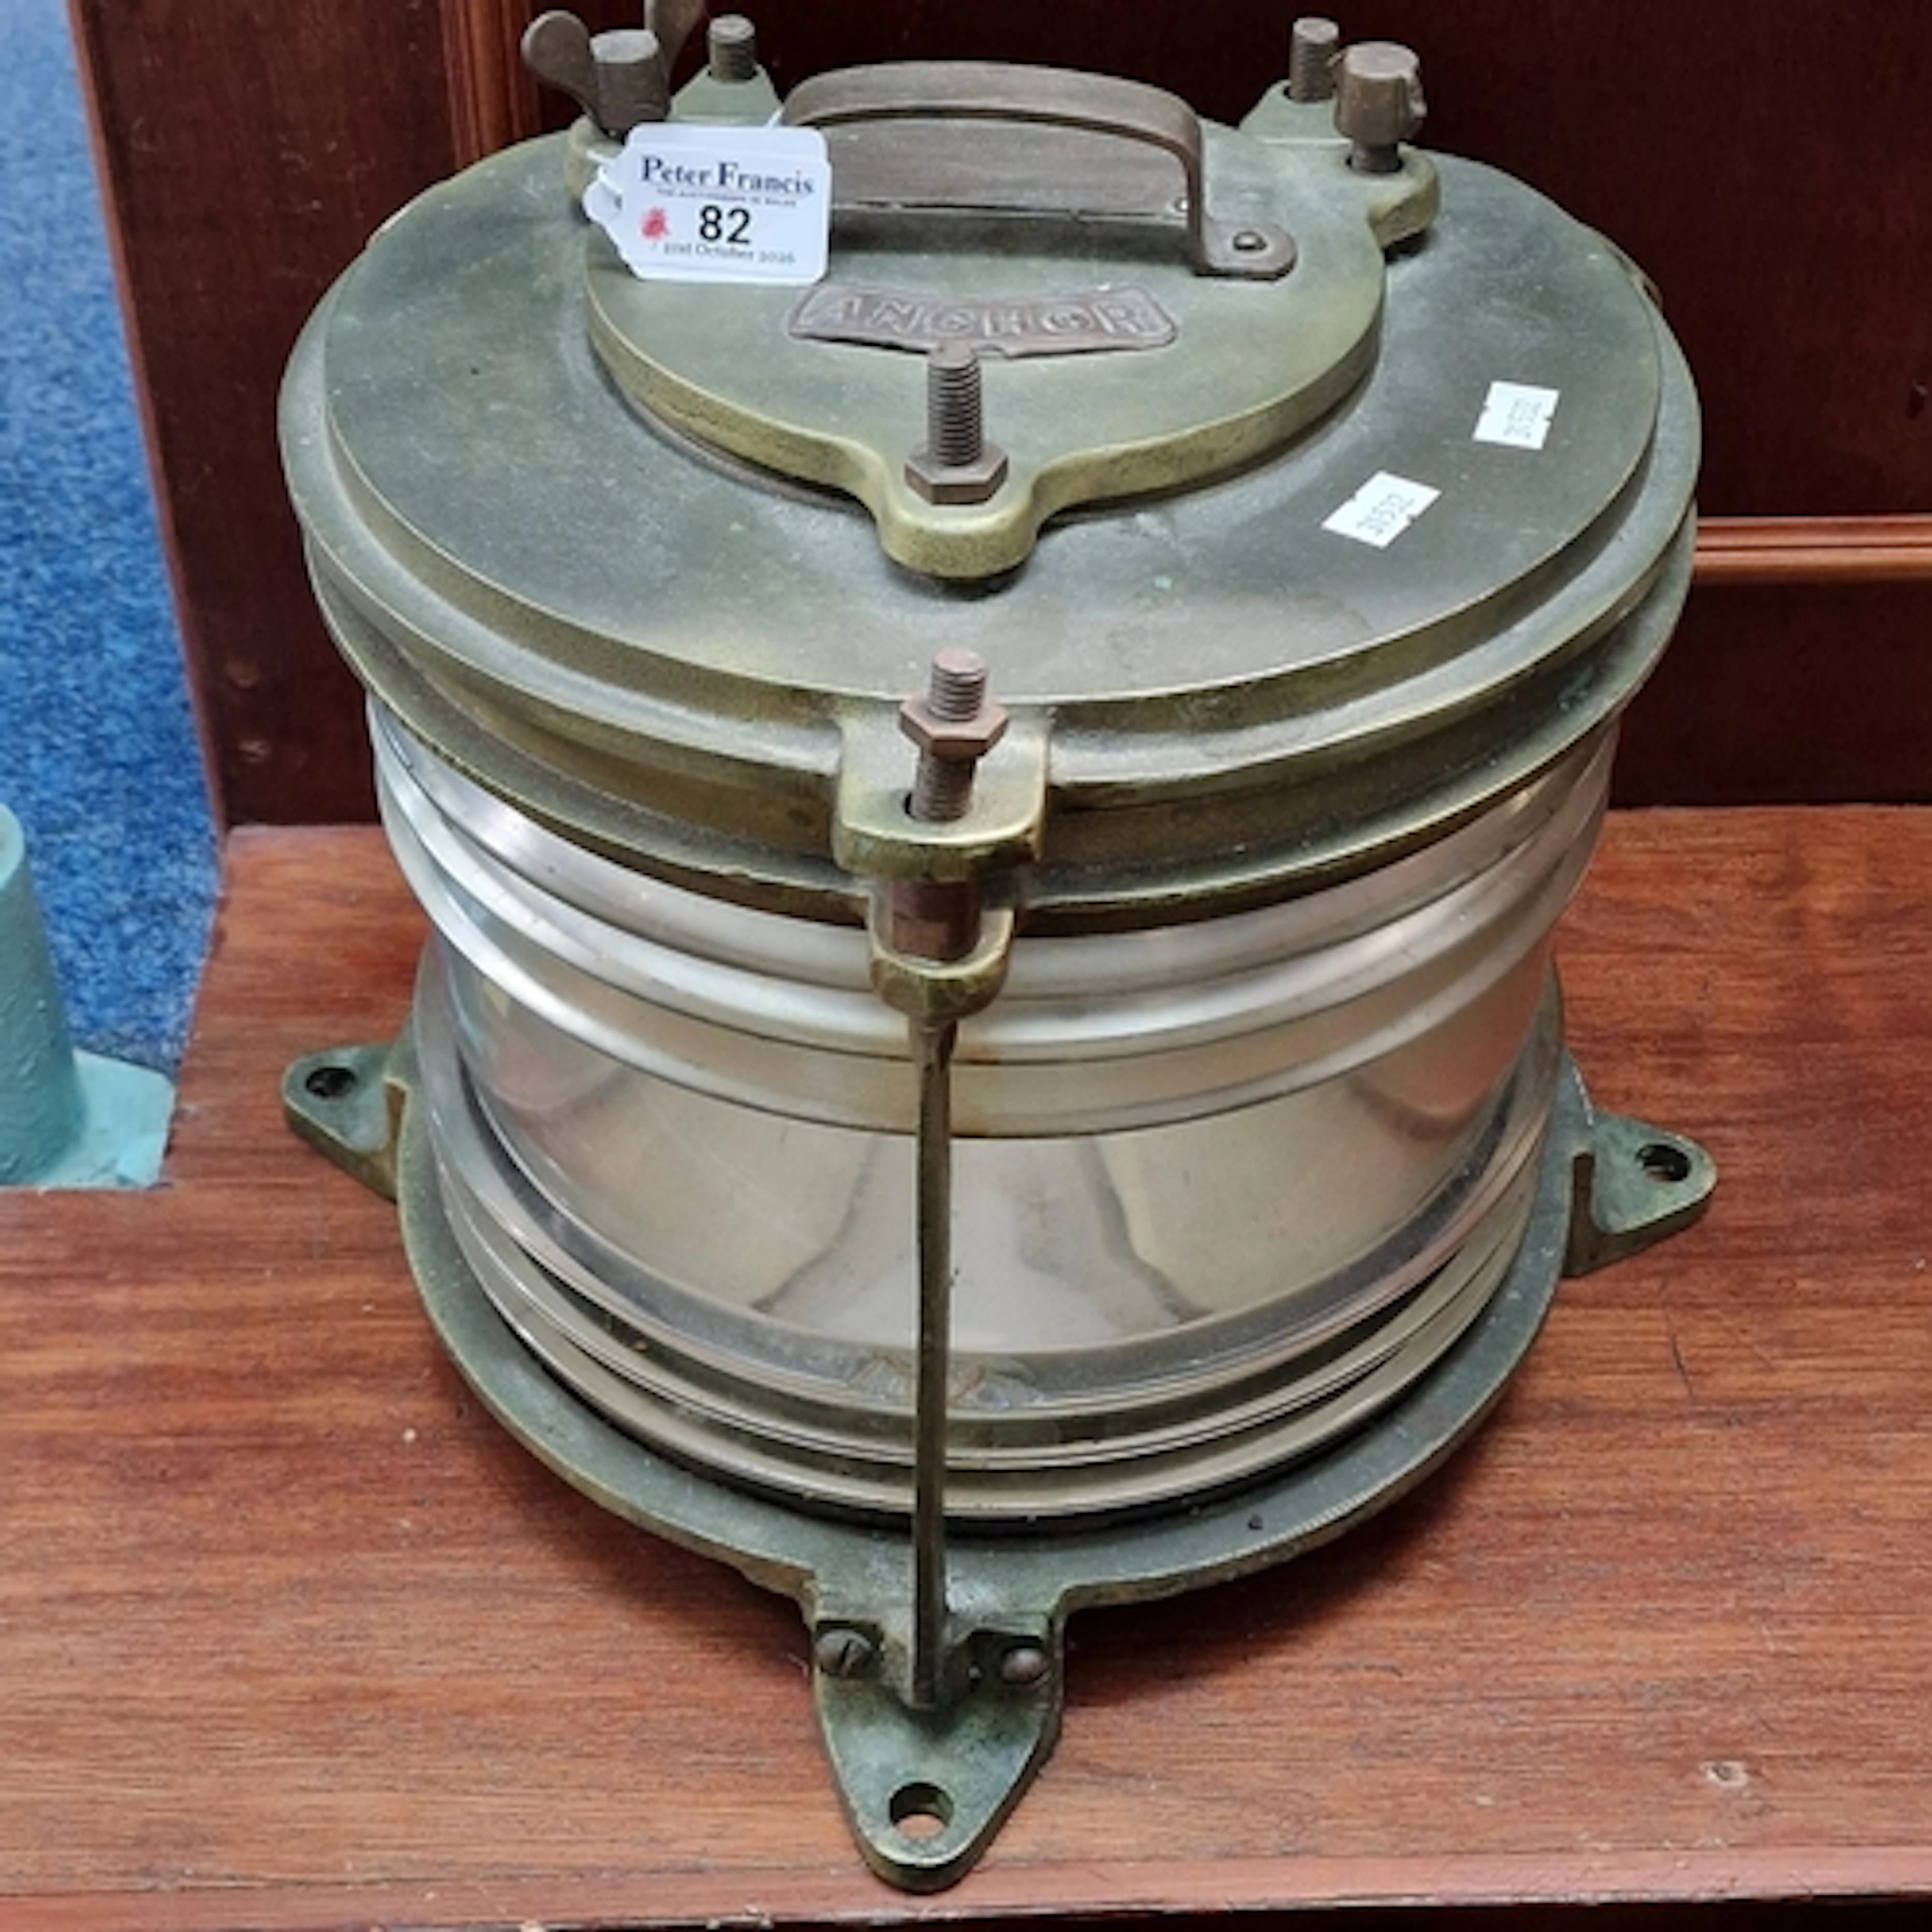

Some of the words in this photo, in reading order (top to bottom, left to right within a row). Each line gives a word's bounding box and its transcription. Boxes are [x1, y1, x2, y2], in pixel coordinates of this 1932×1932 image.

[641, 154, 711, 185] Peter
[718, 161, 814, 194] Francis
[699, 204, 752, 244] 82
[805, 295, 1146, 337] ANCHOR
